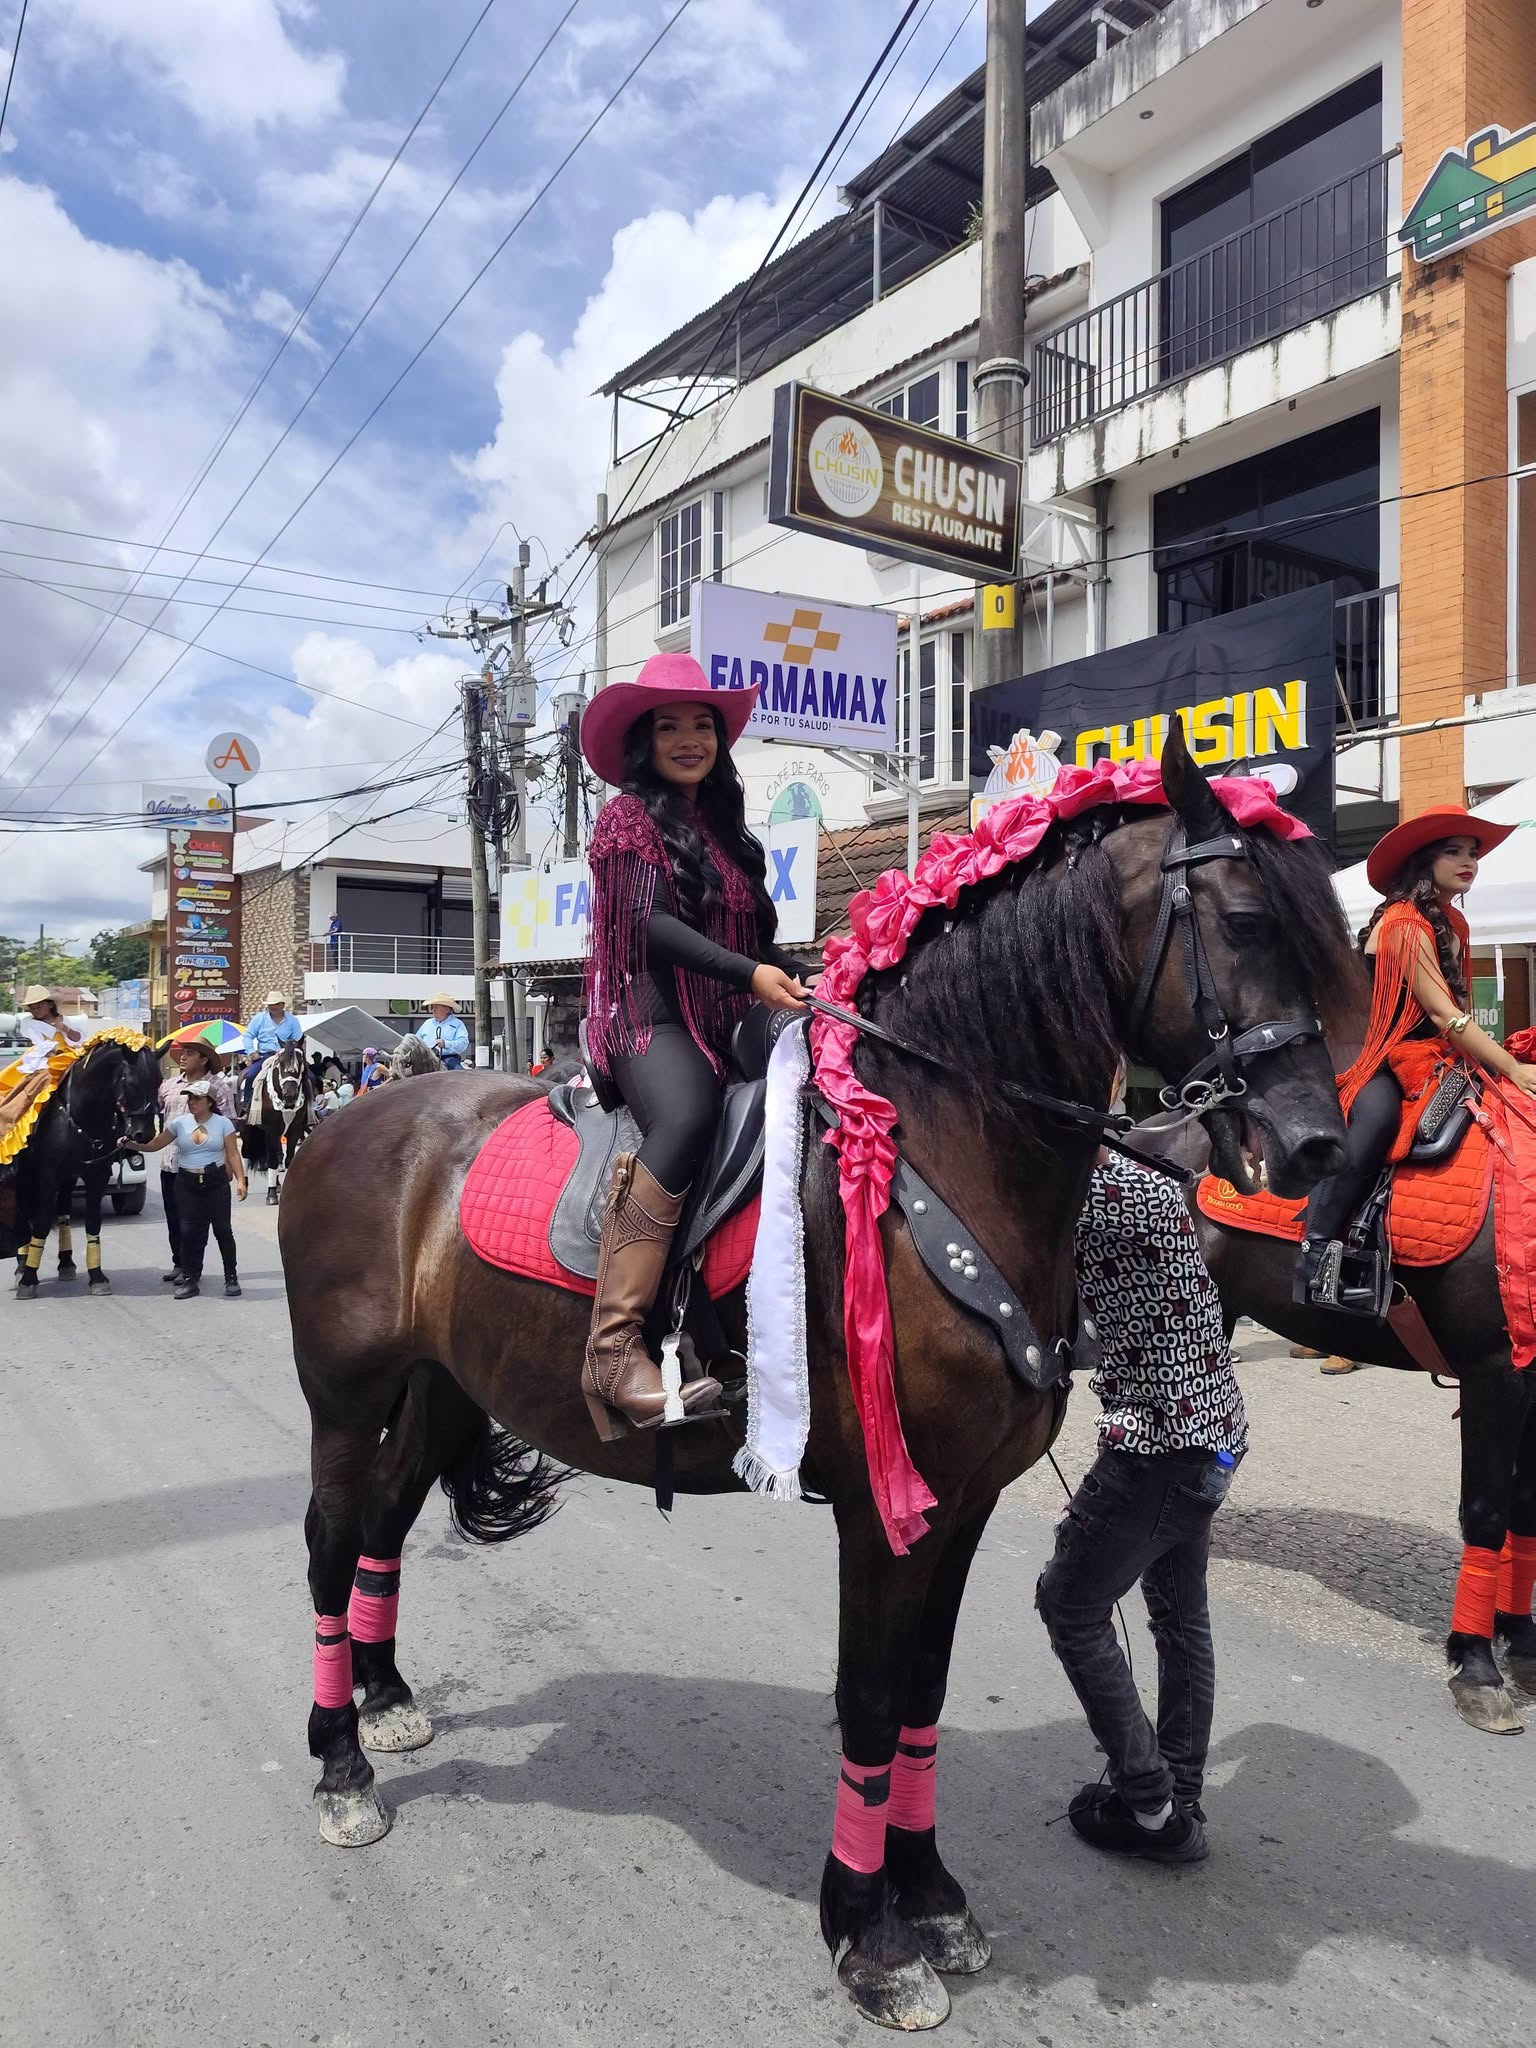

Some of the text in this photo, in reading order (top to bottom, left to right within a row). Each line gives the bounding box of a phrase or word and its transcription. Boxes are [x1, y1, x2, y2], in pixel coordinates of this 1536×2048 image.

[814, 448, 878, 488] CHUSIN
[894, 445, 1006, 526] CHUSIN
[892, 501, 1003, 552] RESTAURANTE
[710, 654, 887, 725] FARMAMAX
[761, 714, 780, 725] POR
[784, 716, 796, 728] TU
[799, 718, 832, 732] SALUD!
[766, 761, 831, 801] CAFÉ DE PARIS
